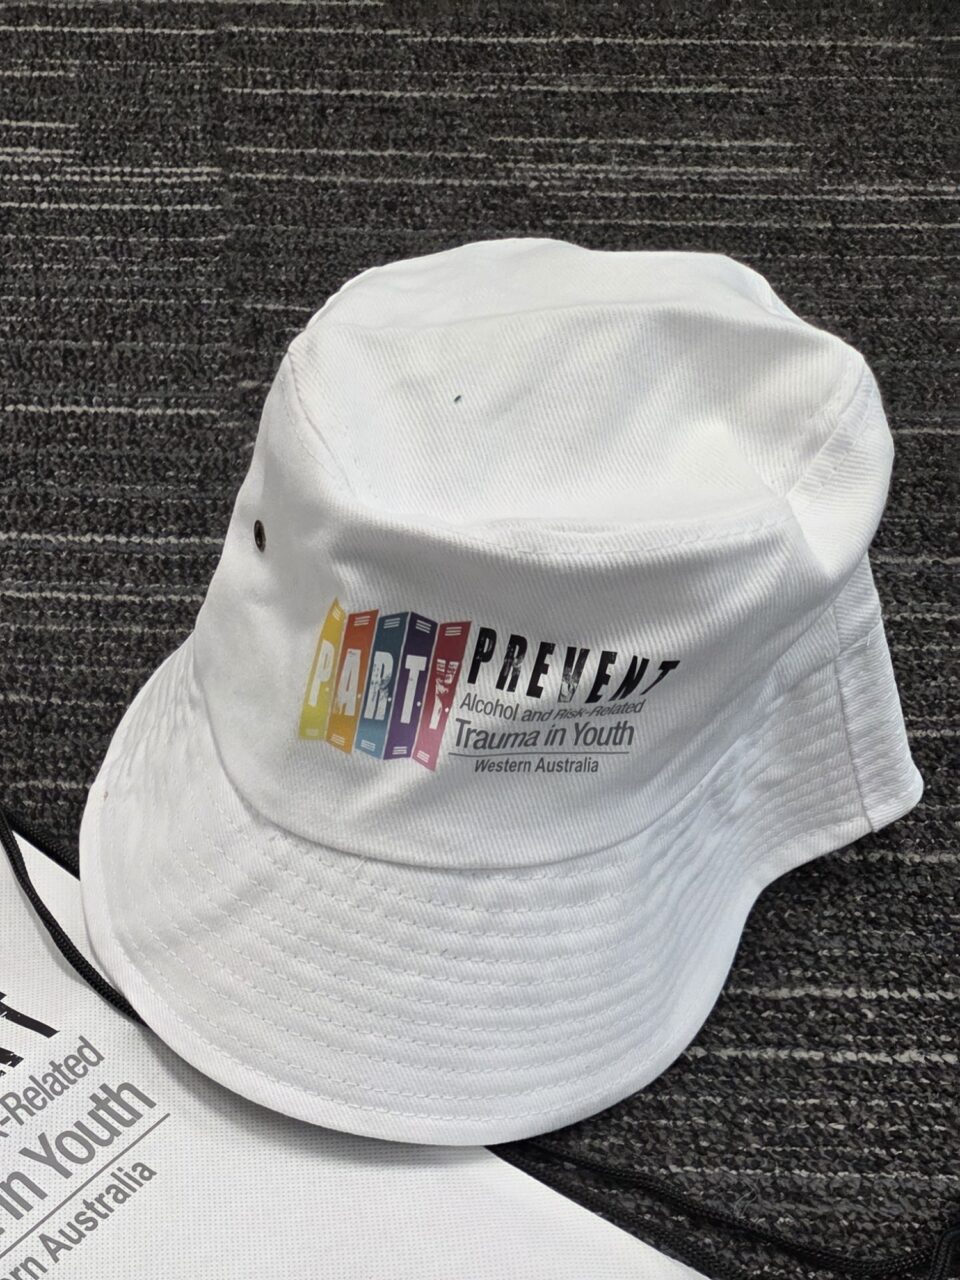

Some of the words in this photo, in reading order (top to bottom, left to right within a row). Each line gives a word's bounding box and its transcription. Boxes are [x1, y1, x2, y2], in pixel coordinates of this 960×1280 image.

[467, 626, 680, 704] PREVENT
[458, 691, 520, 722] Alcohol
[521, 705, 552, 722] and
[553, 699, 646, 722] Risk-Related
[454, 718, 541, 751] Trauma
[544, 719, 568, 747] in
[572, 720, 635, 747] Youth
[474, 757, 531, 774] Western
[535, 756, 599, 774] Australia
[20, 1081, 158, 1180] Youth
[38, 1160, 157, 1264] Australia
